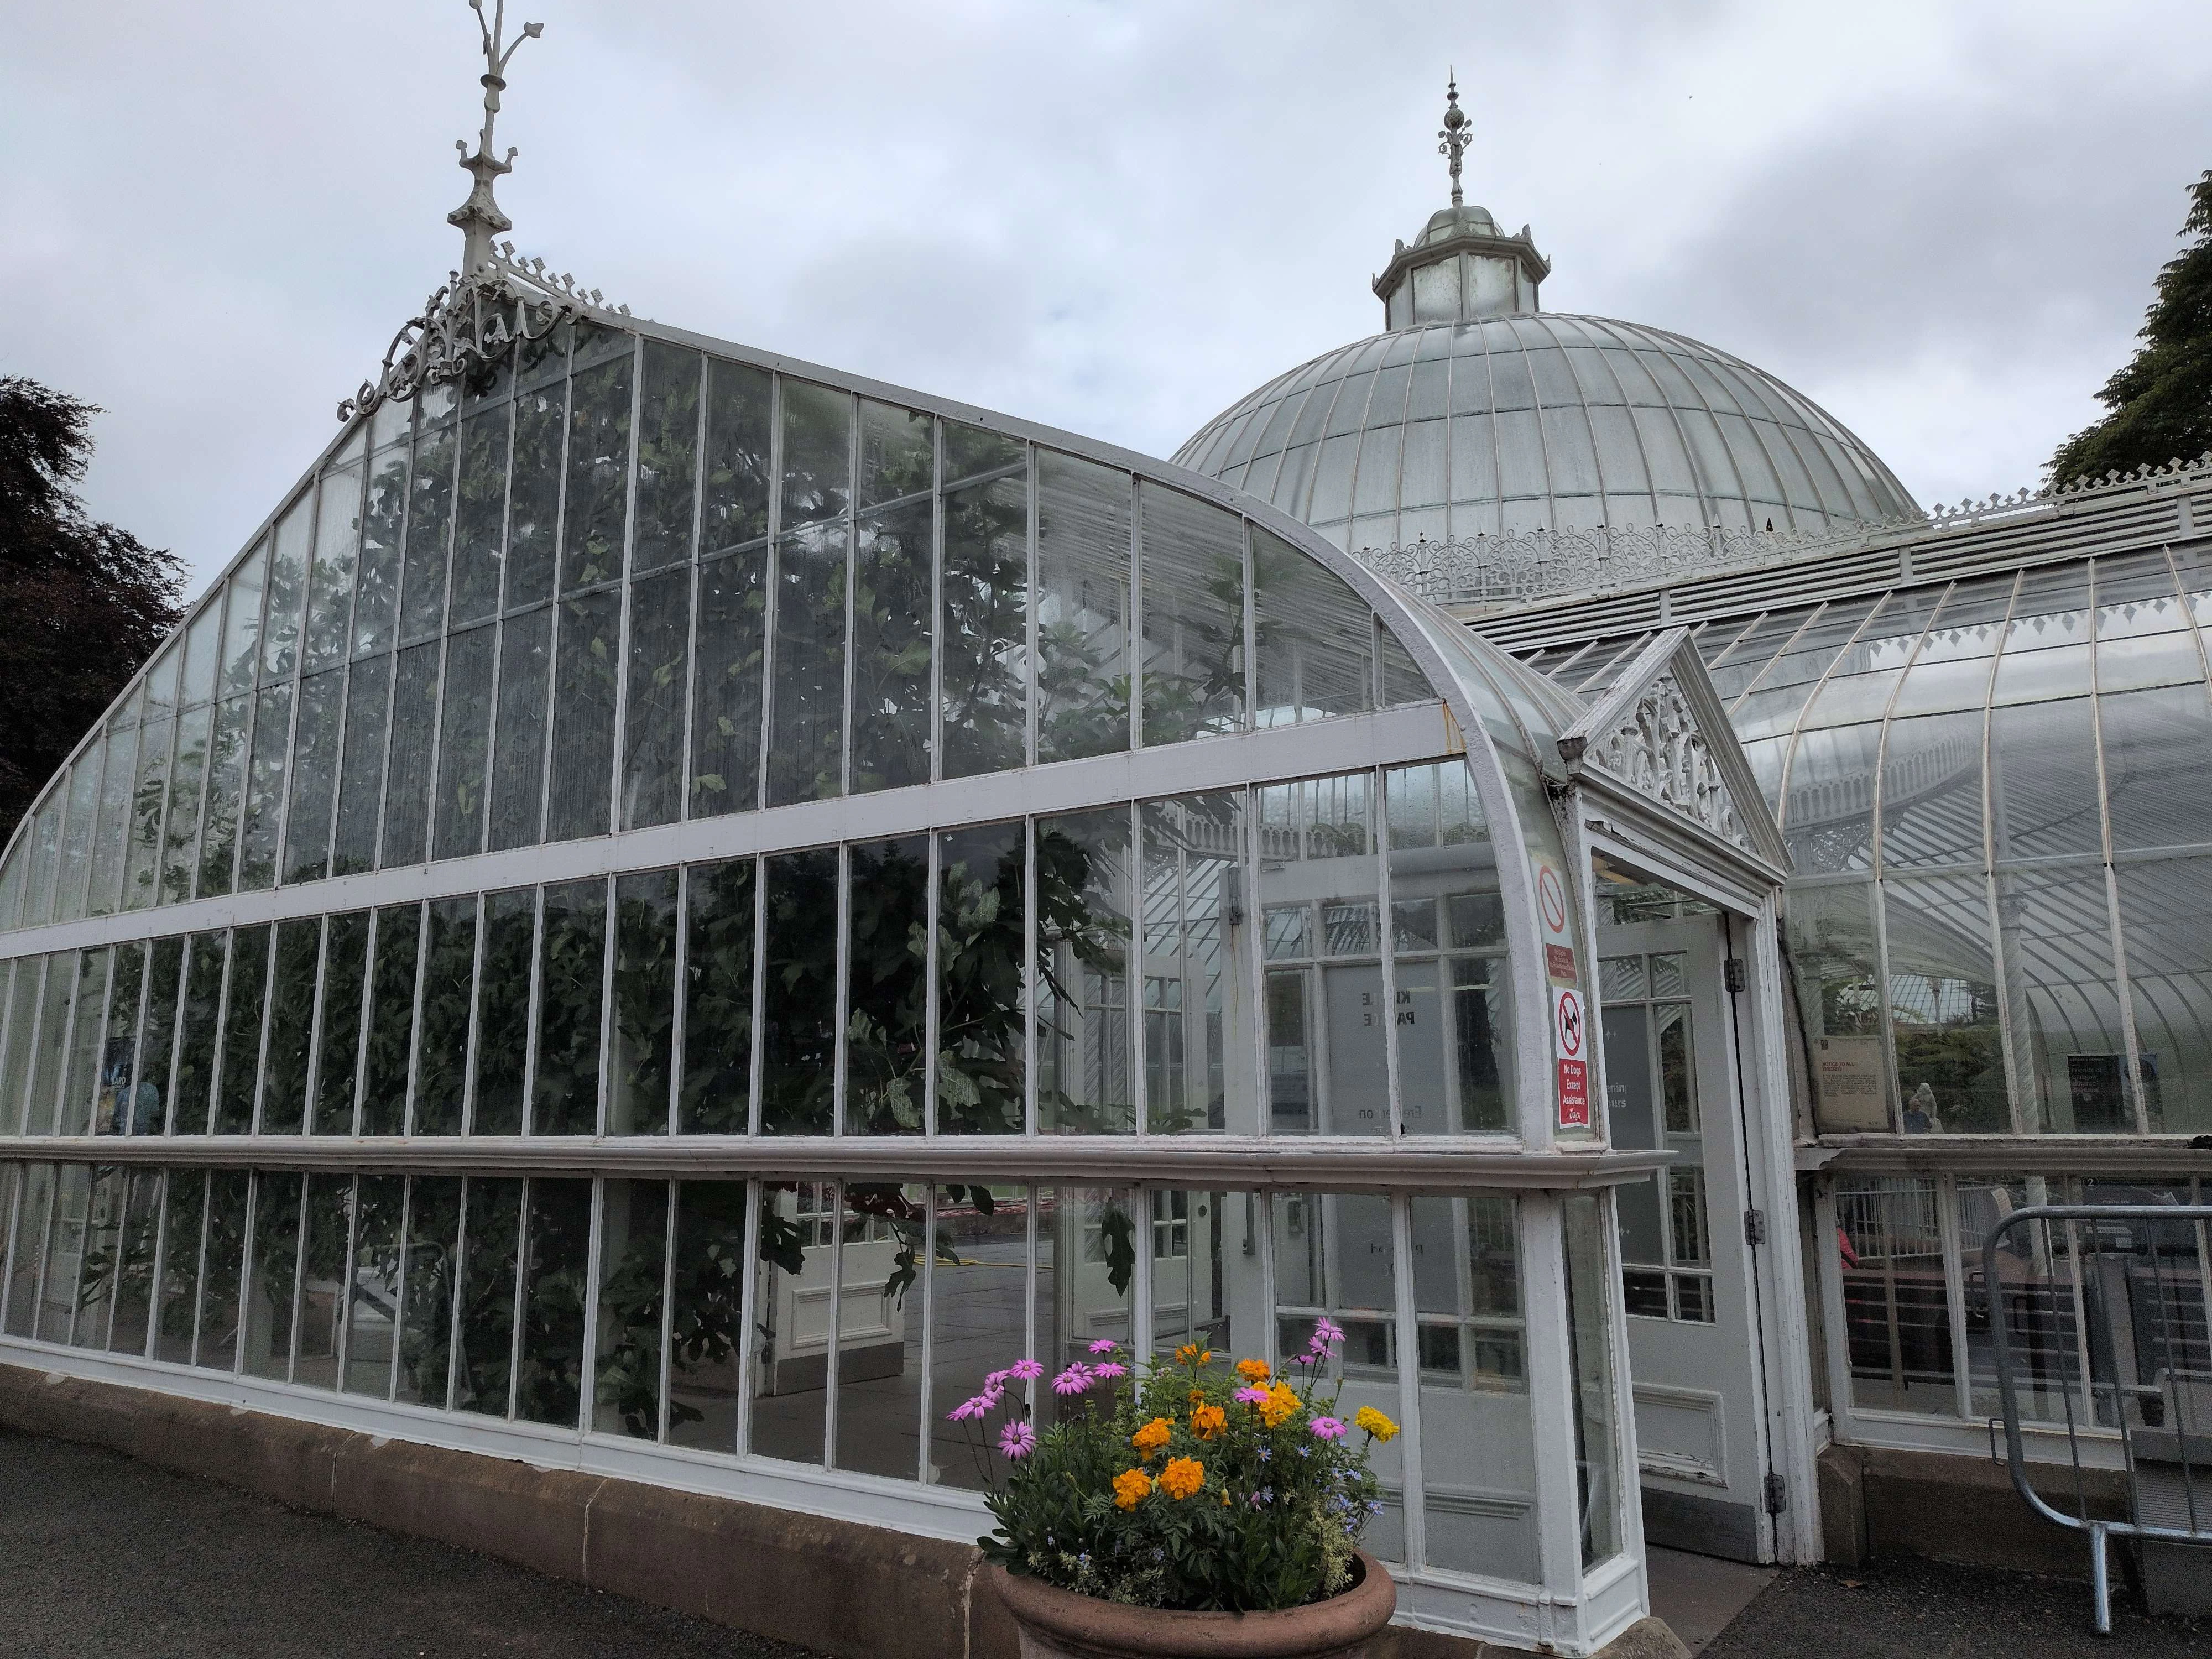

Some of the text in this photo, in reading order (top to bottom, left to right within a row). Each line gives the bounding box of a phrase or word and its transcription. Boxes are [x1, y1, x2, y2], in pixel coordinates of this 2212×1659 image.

[1564, 1063, 1582, 1077] No Dogs
[1566, 1079, 1580, 1092] Except
[1563, 1094, 1585, 1105] Assistance
[2087, 1178, 2095, 1187] 2
